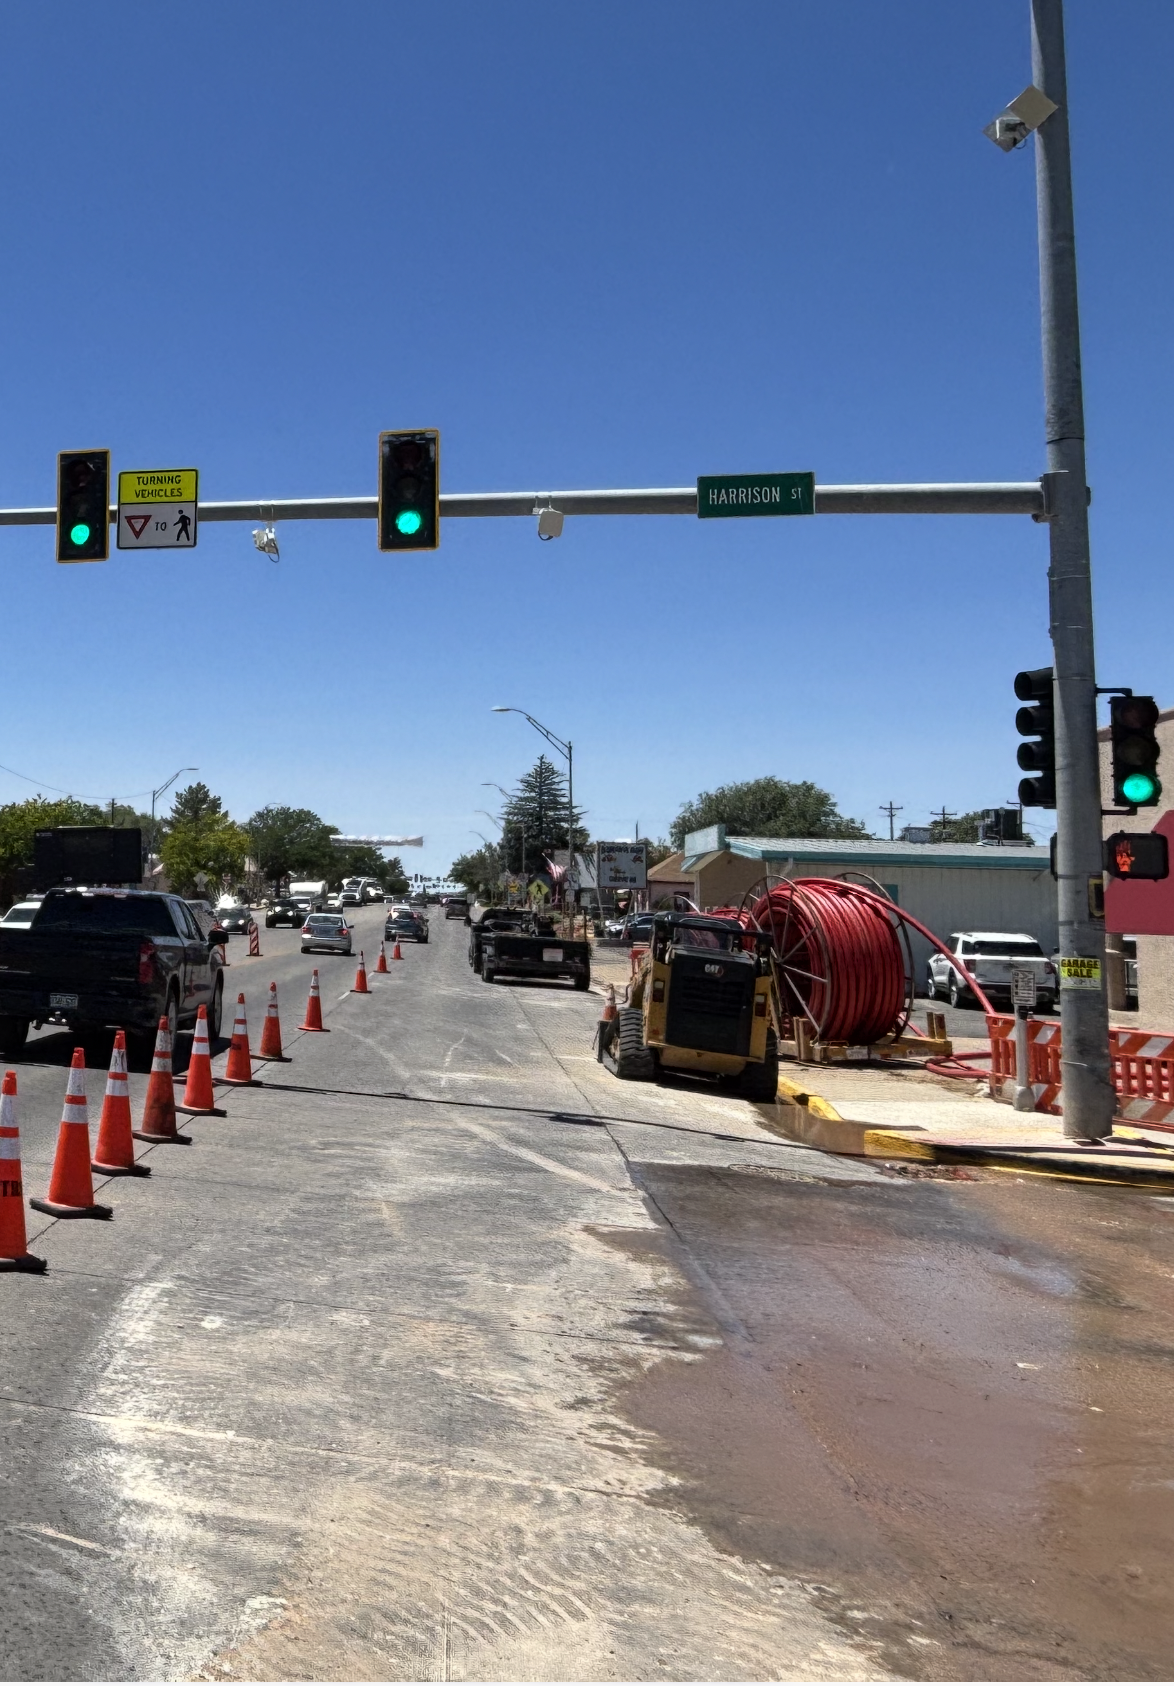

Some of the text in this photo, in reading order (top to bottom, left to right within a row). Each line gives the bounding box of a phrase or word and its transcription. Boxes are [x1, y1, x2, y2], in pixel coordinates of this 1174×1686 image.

[136, 475, 182, 486] TURNING
[134, 488, 183, 498] VEHICLES
[709, 486, 802, 505] HARRISON ST
[155, 521, 167, 531] TO
[1061, 959, 1100, 969] GARAGE
[1067, 968, 1093, 978] SALE
